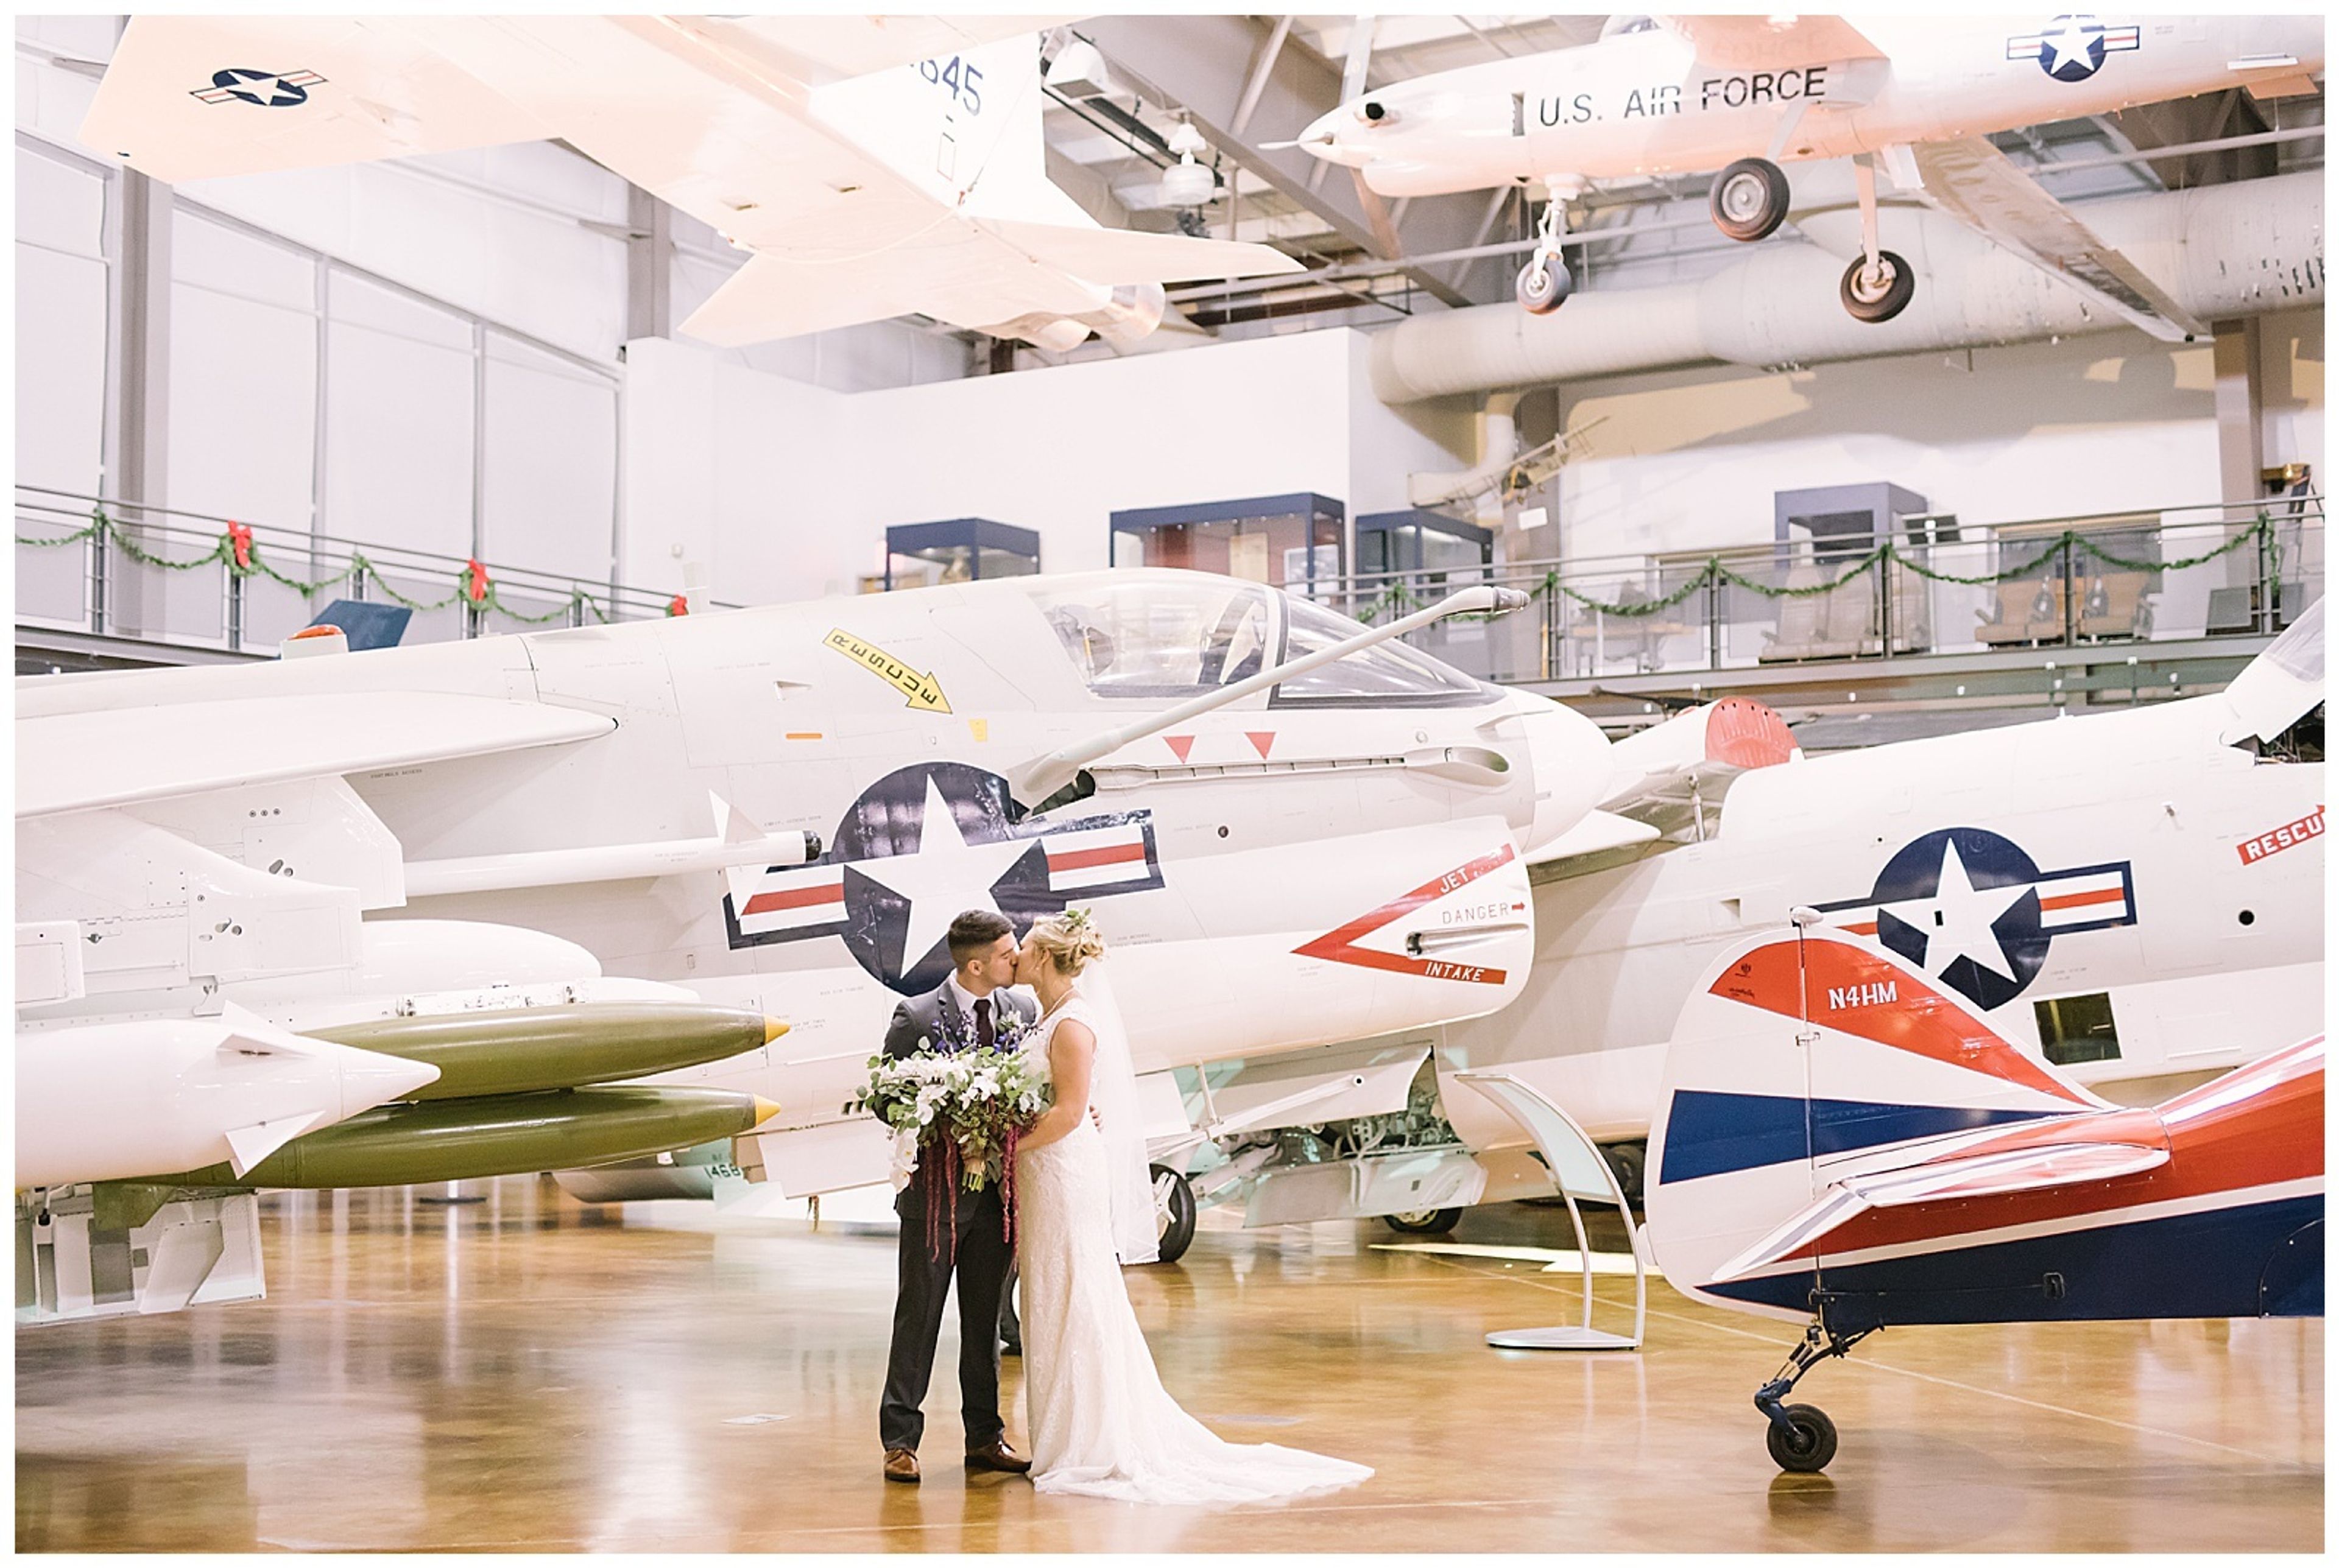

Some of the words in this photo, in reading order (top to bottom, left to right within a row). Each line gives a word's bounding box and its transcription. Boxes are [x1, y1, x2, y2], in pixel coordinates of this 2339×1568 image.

[1539, 93, 1603, 127] U.S.
[1623, 85, 1681, 118] AIR
[1701, 66, 1828, 110] FORCE
[831, 634, 938, 705] RESCUE
[2245, 815, 2324, 860] RESCU
[1439, 867, 1470, 894] JET
[1442, 902, 1509, 924] DANGER
[1425, 961, 1485, 981] INTAKE
[1827, 980, 1899, 1010] N4HM
